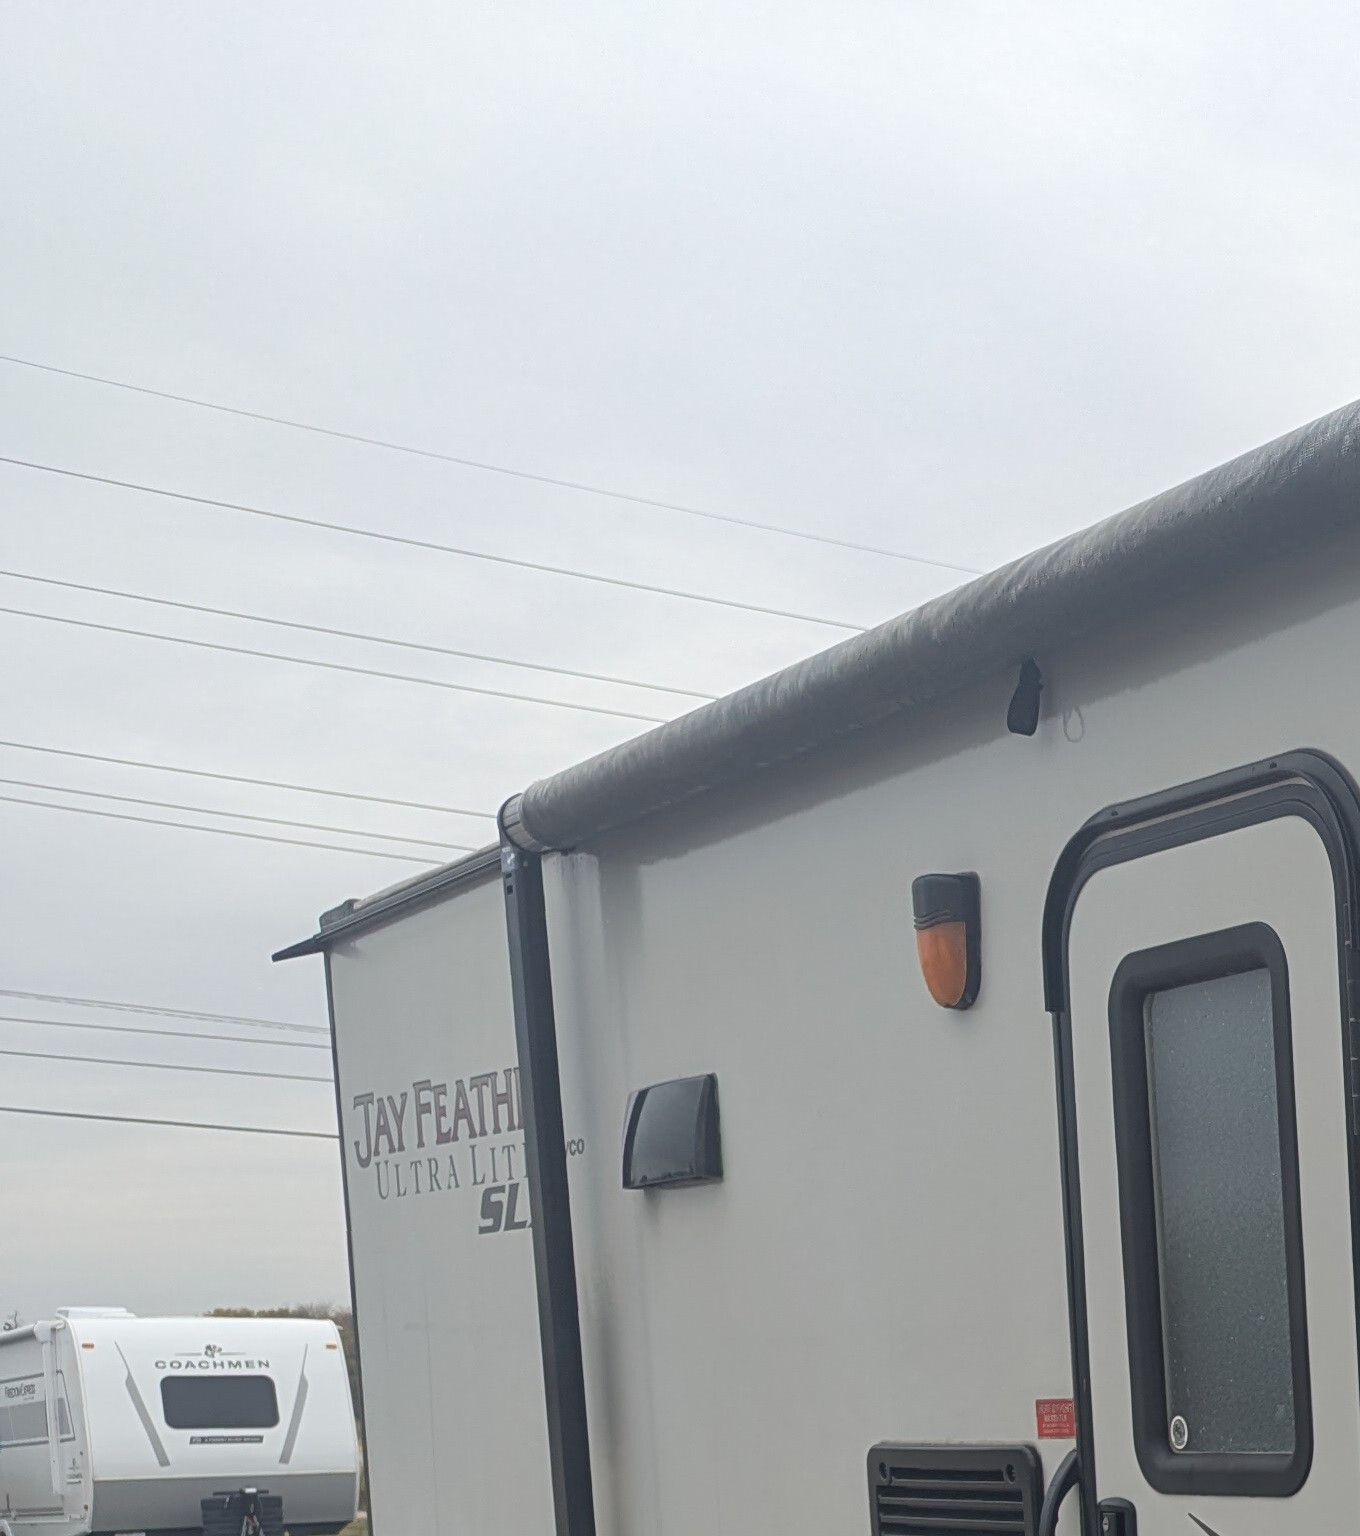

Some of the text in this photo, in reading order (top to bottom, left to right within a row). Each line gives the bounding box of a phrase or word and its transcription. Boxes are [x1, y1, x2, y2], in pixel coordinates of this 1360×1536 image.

[353, 1066, 525, 1169] JAY FEATH
[374, 1142, 528, 1201] ULTRA LIT
[478, 1182, 533, 1236] SL
[154, 1360, 270, 1370] COACHMEN
